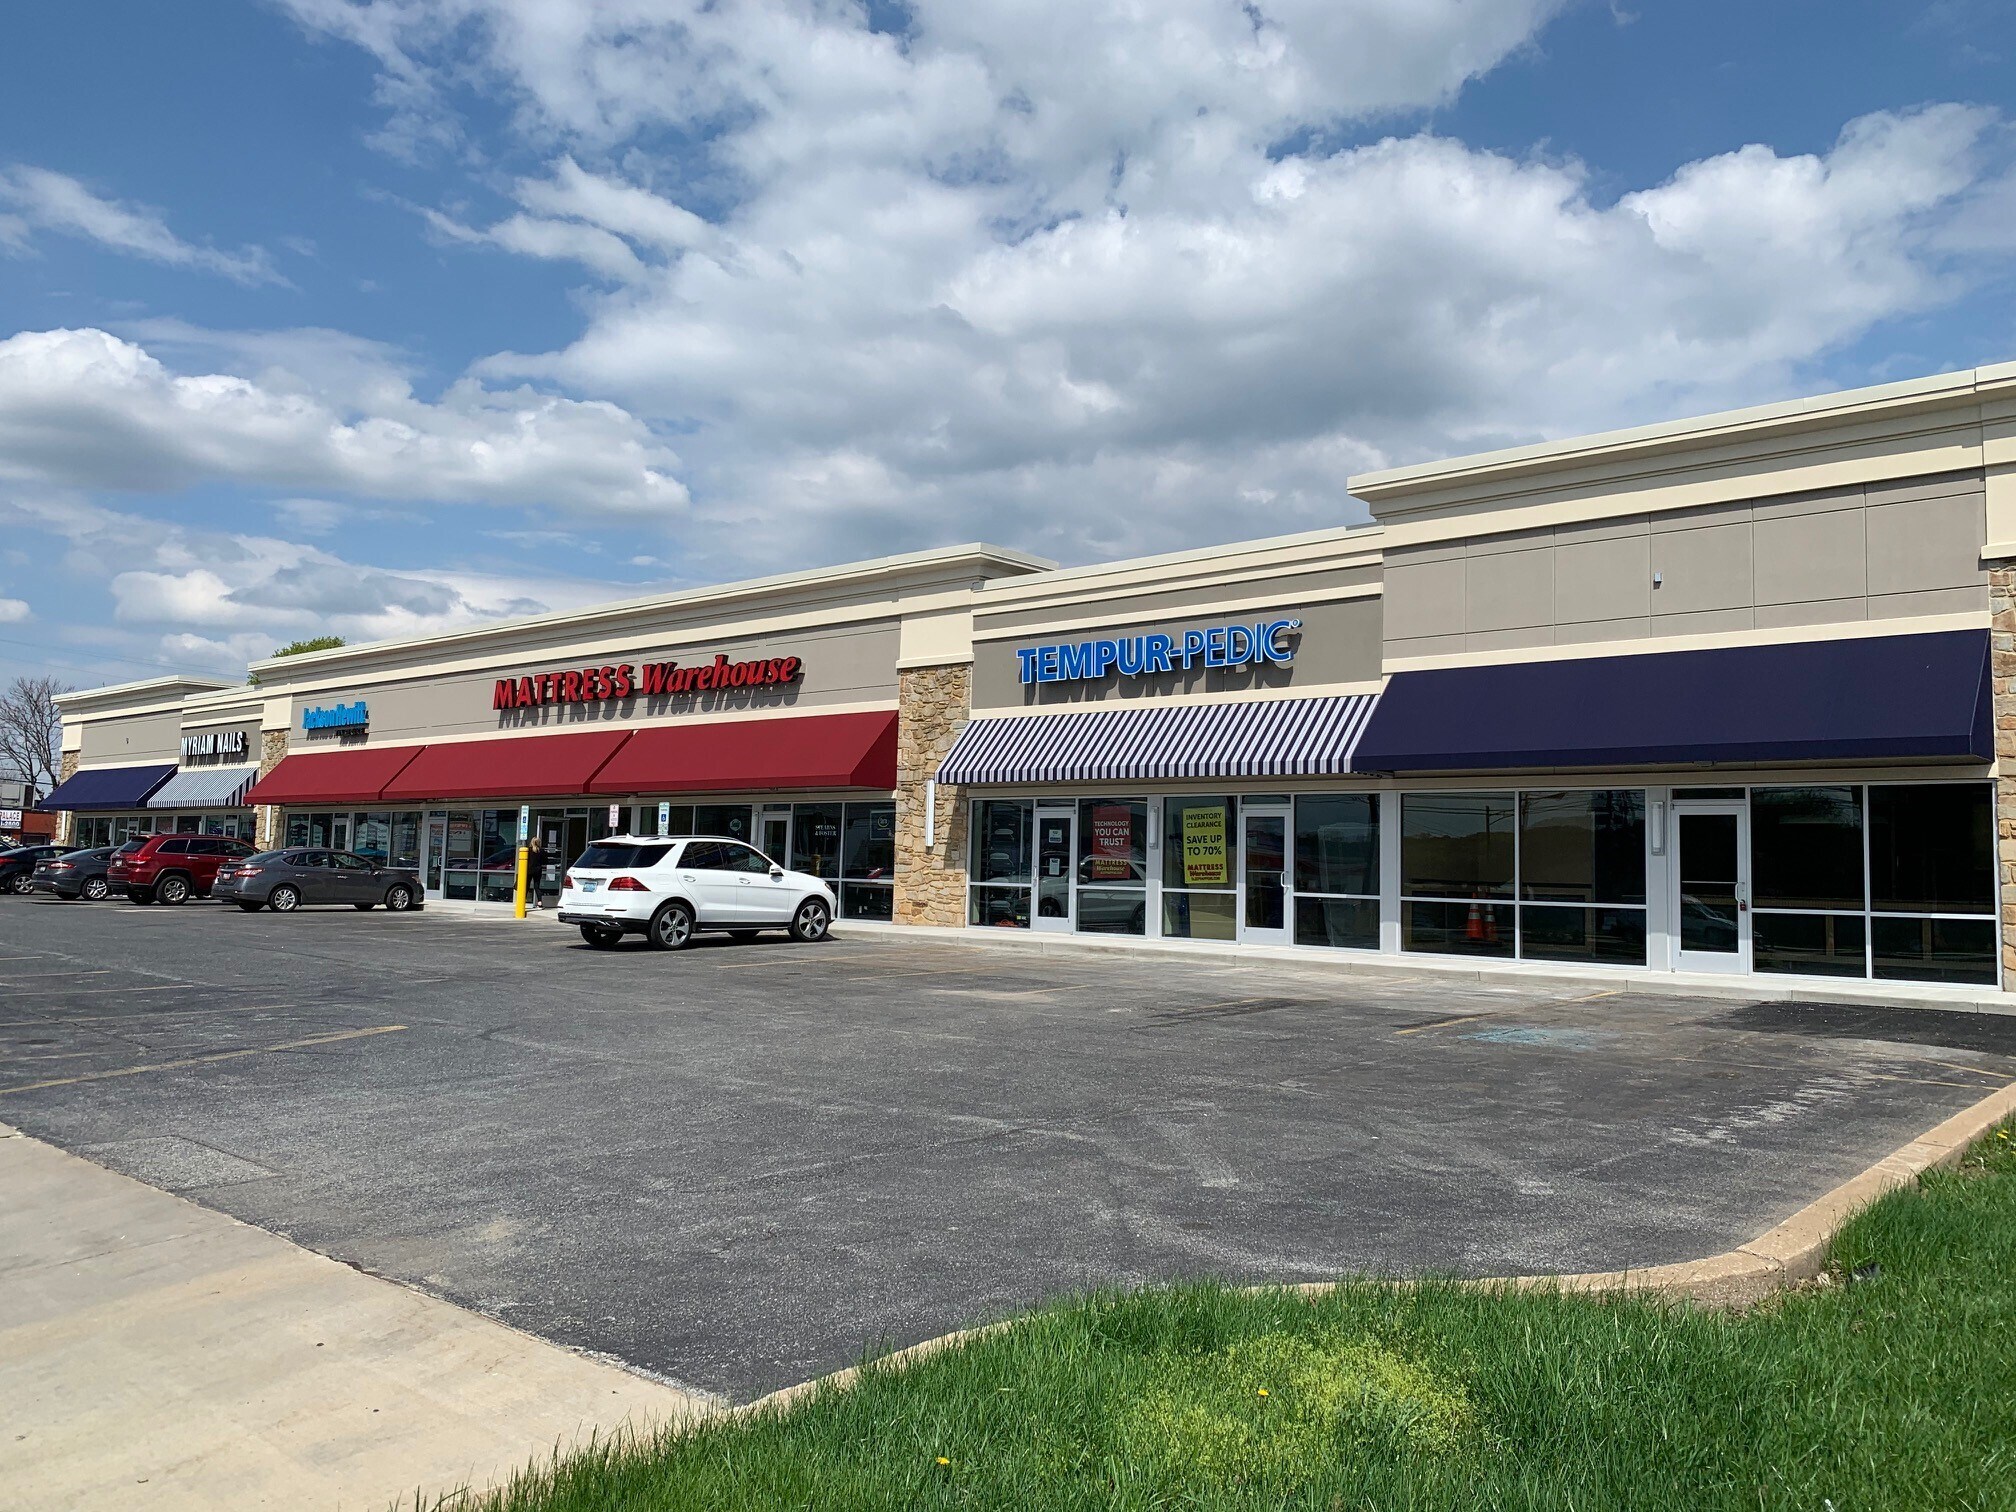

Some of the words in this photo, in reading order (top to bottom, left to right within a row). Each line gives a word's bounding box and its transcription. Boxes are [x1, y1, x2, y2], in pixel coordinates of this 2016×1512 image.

[493, 664, 634, 710] MATTRESS
[642, 654, 802, 695] Warehouse
[181, 734, 214, 756] MYRIAM
[217, 731, 243, 753] NAILS
[1099, 837, 1124, 846] TRUST
[1186, 835, 1208, 844] SAVE
[1210, 834, 1222, 843] UP
[1187, 846, 1201, 856] TO
[1203, 846, 1222, 855] 70%
